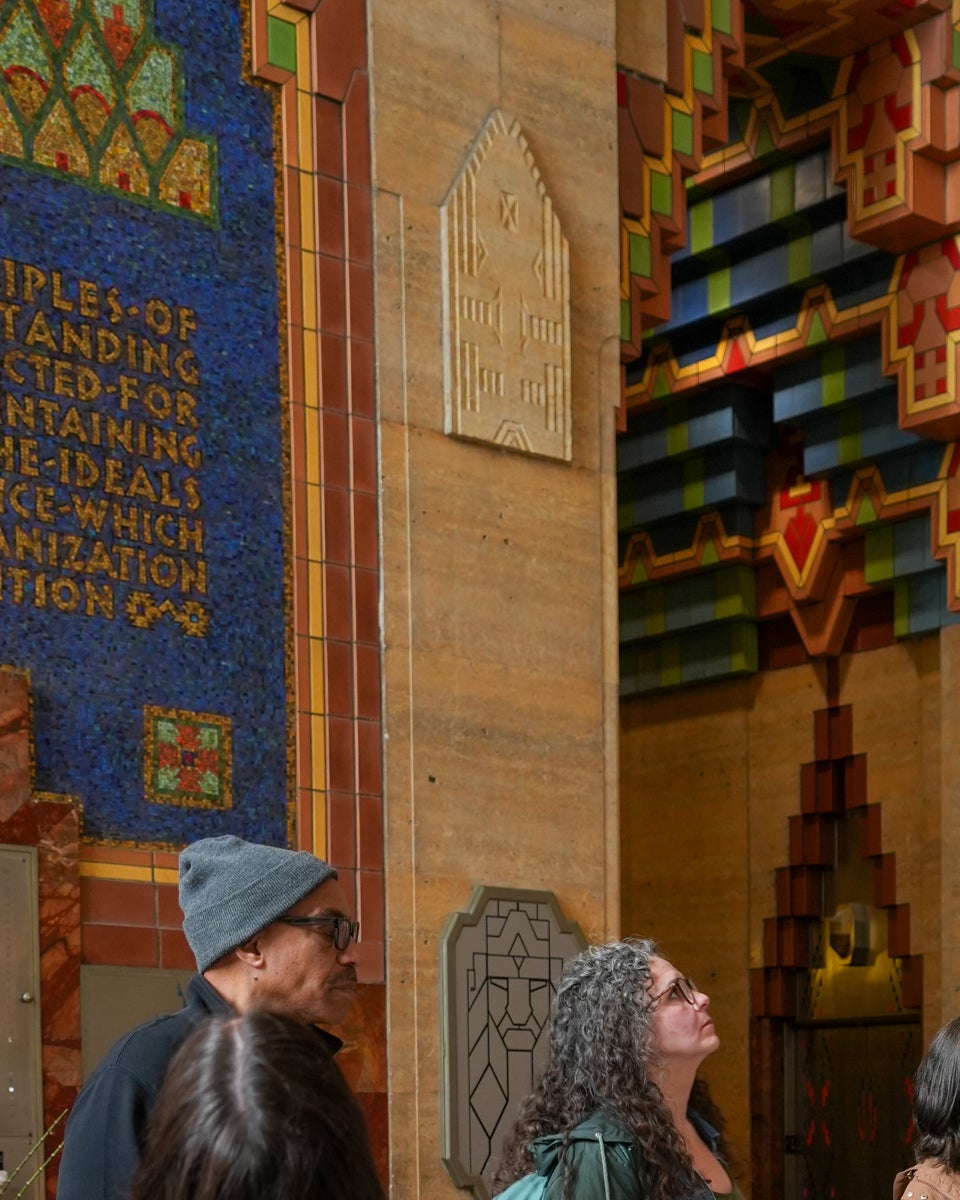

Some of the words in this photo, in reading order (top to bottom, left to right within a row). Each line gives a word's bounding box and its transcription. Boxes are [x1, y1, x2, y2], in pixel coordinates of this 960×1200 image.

[145, 299, 198, 341] OF
[119, 374, 199, 428] FOR
[0, 392, 200, 469] NTAINING
[59, 448, 200, 511] IDEALS
[71, 493, 204, 553] WHICH
[0, 564, 114, 619] TION
